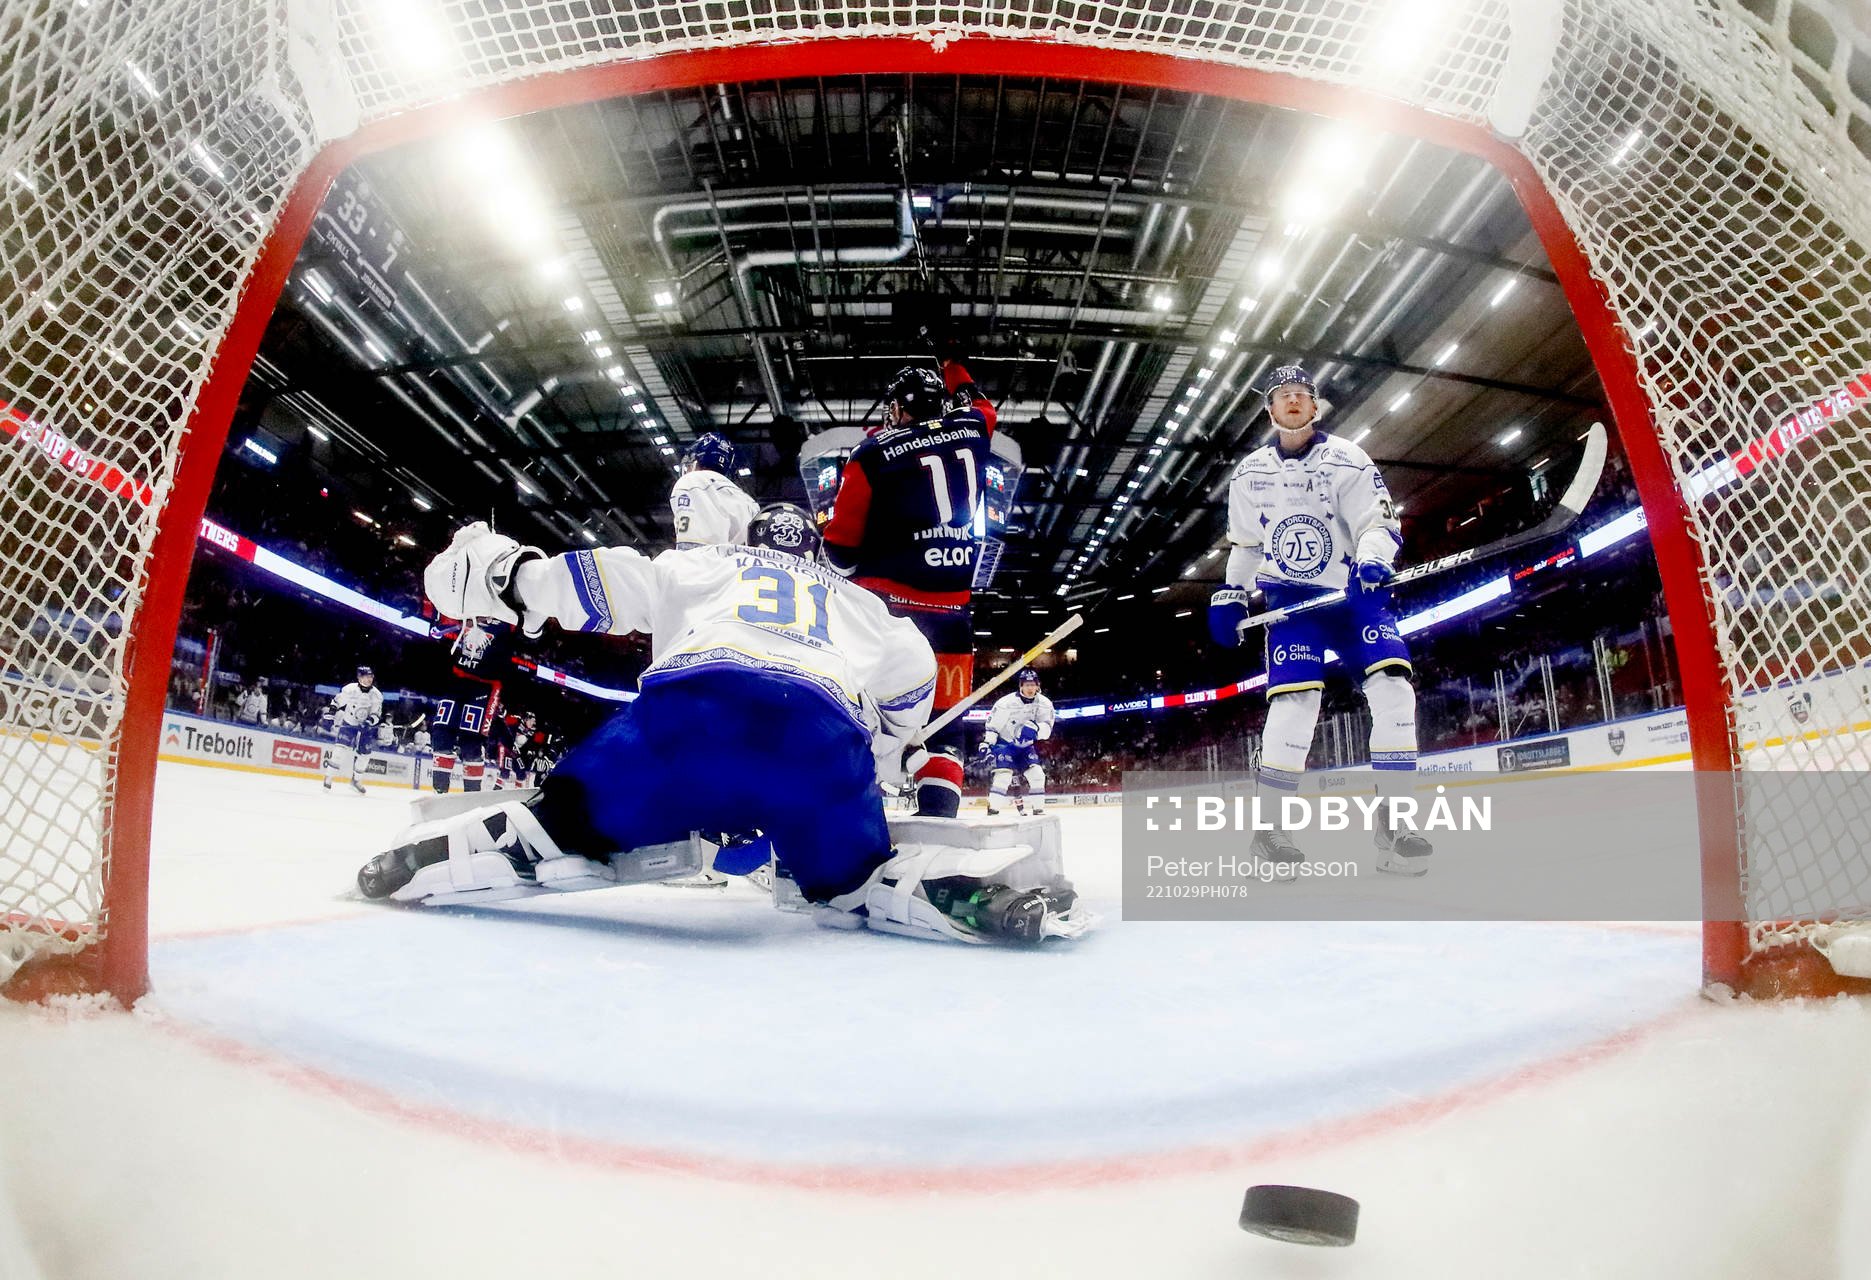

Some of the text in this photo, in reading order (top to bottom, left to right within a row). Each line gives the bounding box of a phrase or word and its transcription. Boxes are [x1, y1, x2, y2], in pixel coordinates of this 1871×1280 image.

[337, 190, 368, 235] 33
[920, 448, 977, 523] 11
[737, 566, 834, 645] 31
[1290, 644, 1311, 652] Clas
[1290, 652, 1321, 663] Ohlson
[1185, 691, 1206, 704] CLUB
[185, 726, 254, 759] Trebolit
[274, 747, 319, 763] CCM
[1448, 760, 1473, 772] Event
